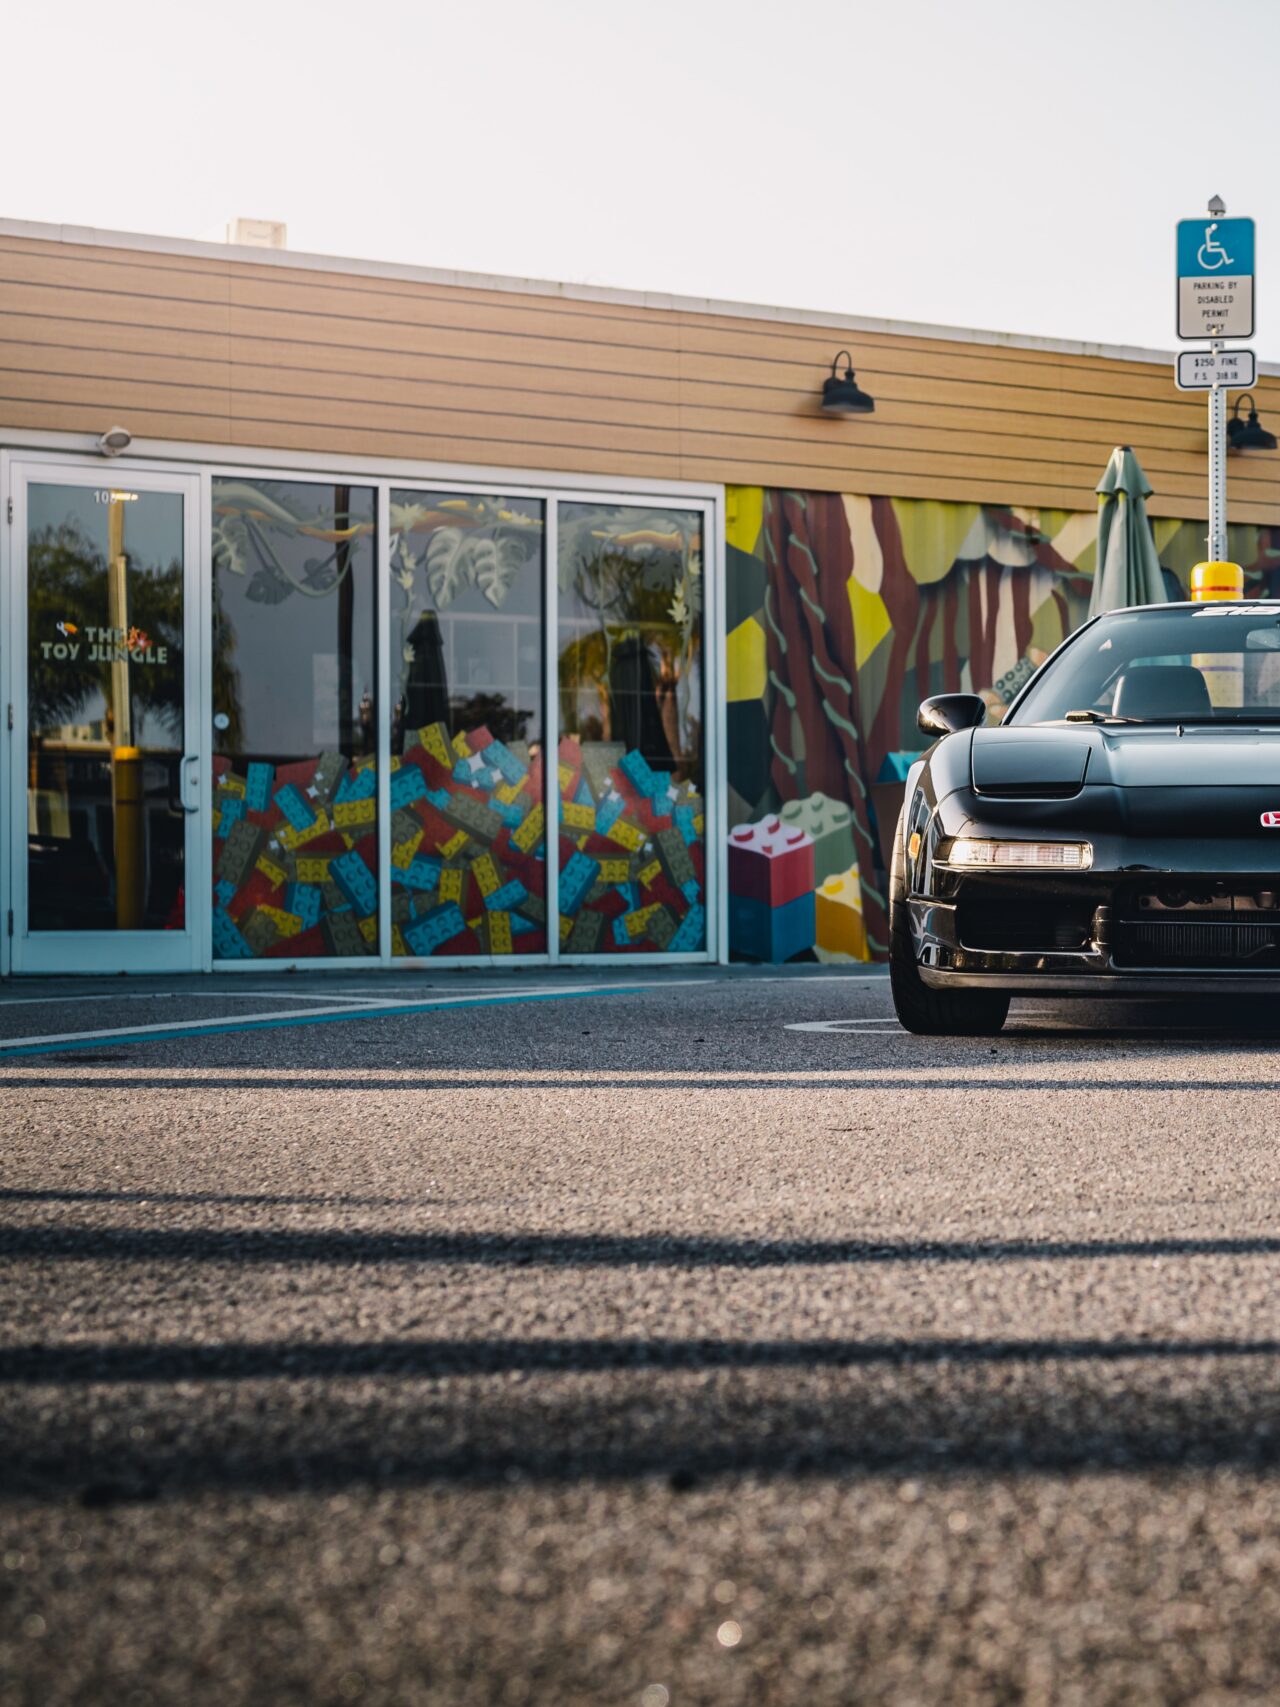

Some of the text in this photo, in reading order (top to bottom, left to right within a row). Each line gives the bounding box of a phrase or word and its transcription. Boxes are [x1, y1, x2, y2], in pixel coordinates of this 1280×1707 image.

[1193, 281, 1238, 290] PARKING BY
[1197, 295, 1234, 304] DISABLED
[1202, 309, 1229, 318] PERMIT
[1195, 357, 1238, 367] $250 FINE
[85, 627, 124, 642] THE
[41, 642, 167, 664] TOY JUNGLE
